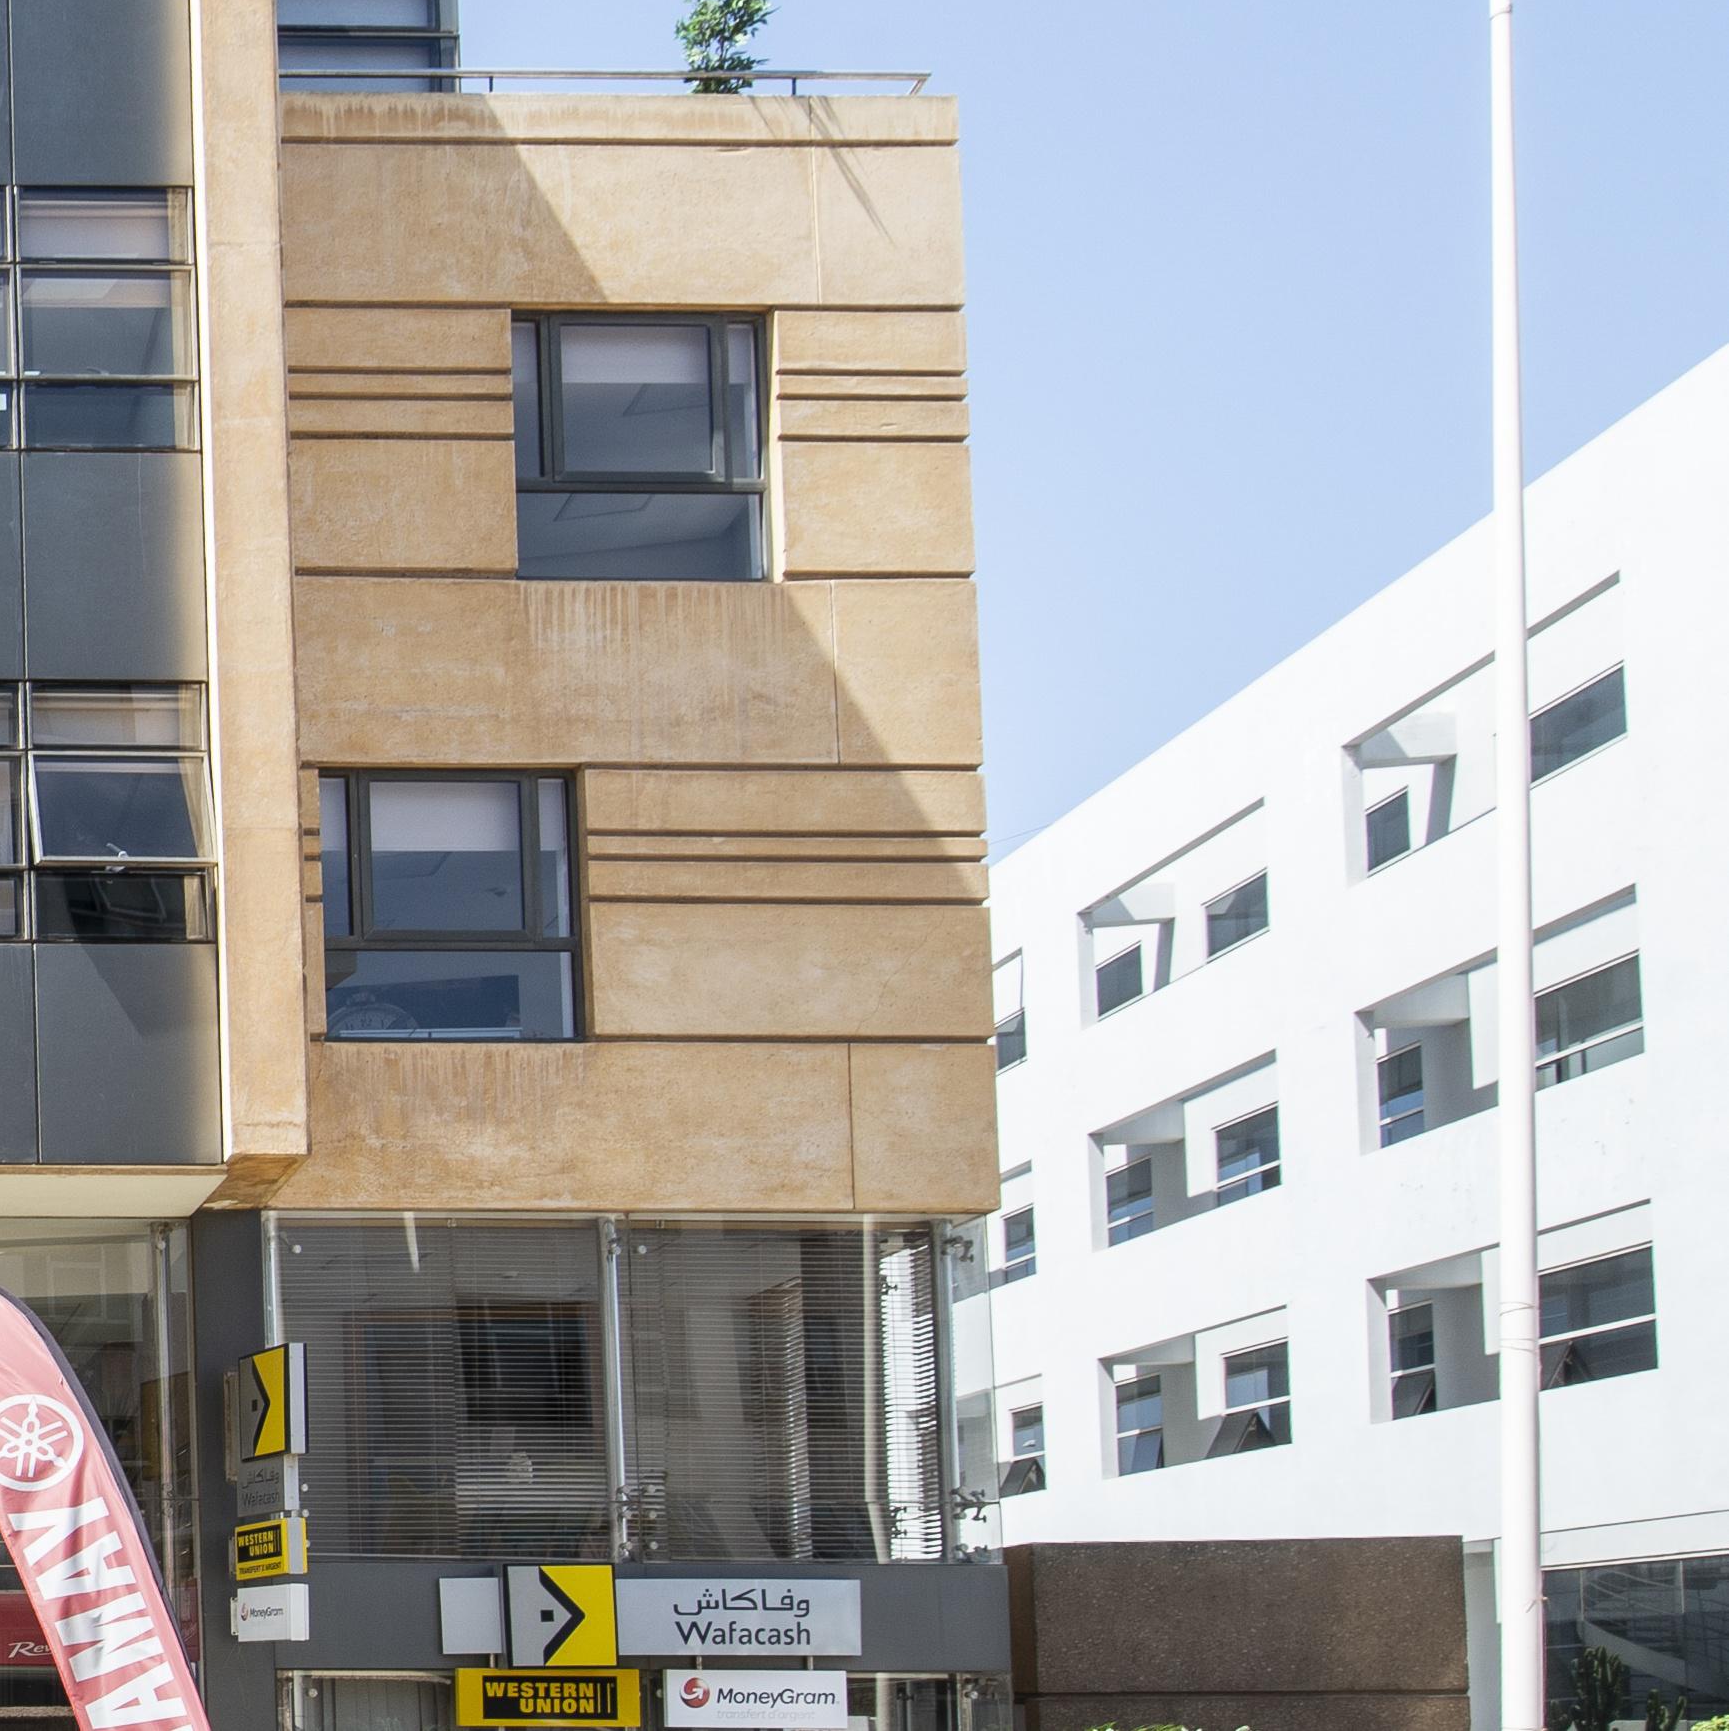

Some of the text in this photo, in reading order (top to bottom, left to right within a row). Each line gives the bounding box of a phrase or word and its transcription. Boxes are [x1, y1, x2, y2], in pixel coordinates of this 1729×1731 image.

[238, 1530, 274, 1548] WESTERN
[249, 1542, 274, 1557] UNION
[673, 1588, 810, 1617] وفاكاش
[249, 1606, 283, 1619] MoneyGram
[675, 1620, 811, 1645] Wafacash
[8, 1642, 52, 1658] Rev
[485, 1682, 594, 1697] WESTERN
[520, 1698, 594, 1714] UNION
[716, 1688, 836, 1709] MoneyGram
[717, 1709, 767, 1719] transfert
